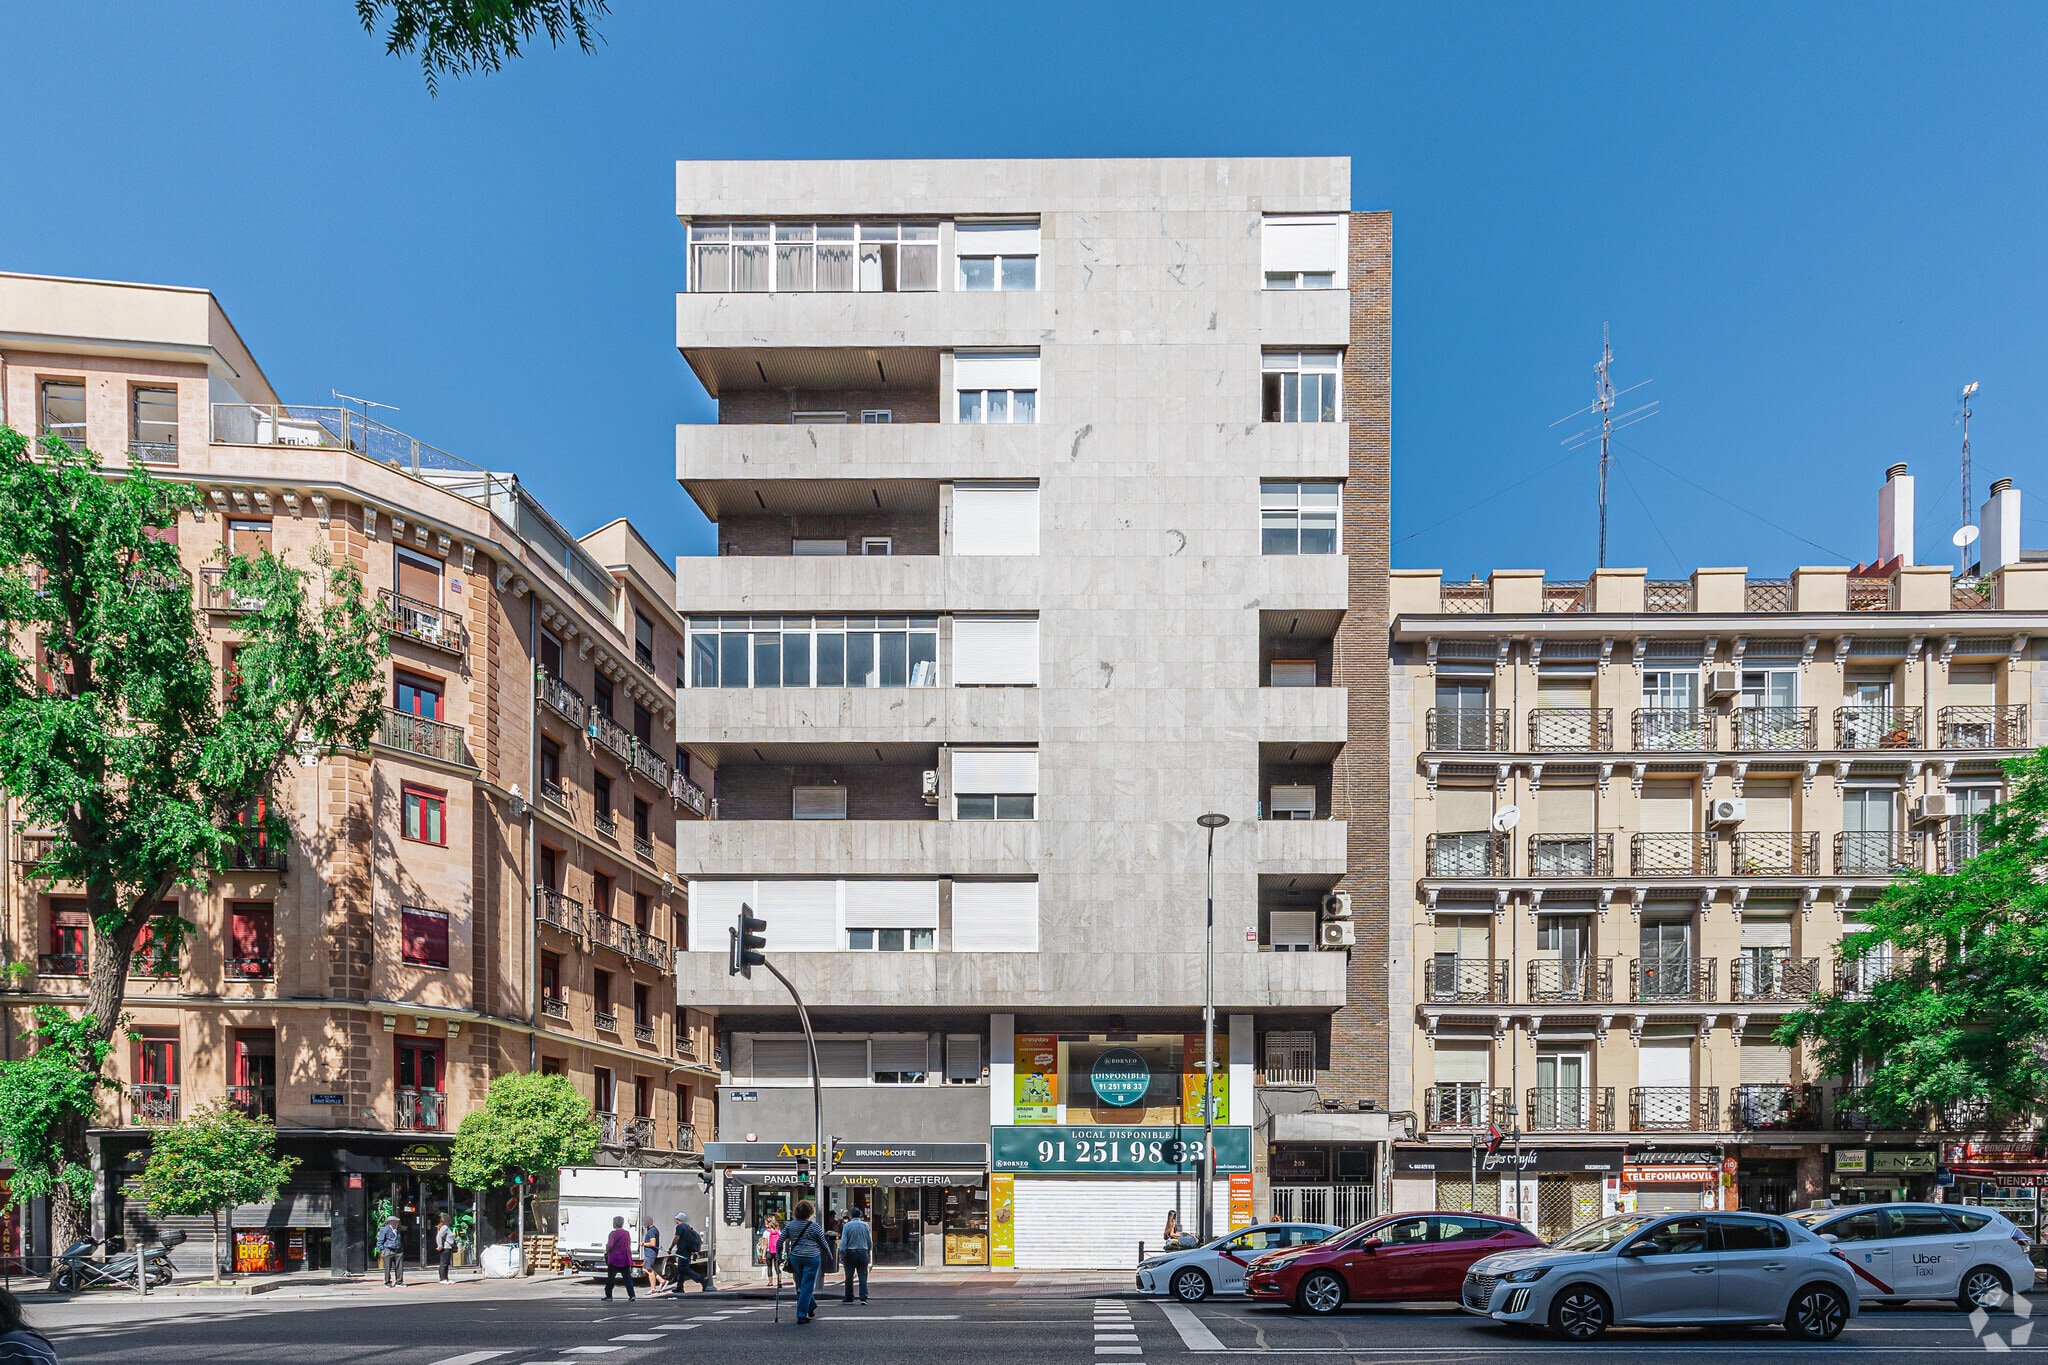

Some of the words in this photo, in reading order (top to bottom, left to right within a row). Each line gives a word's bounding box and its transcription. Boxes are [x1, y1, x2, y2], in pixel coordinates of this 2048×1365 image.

[1095, 1072, 1147, 1080] DISPONIBLE
[1072, 1131, 1106, 1139] LOCAL
[1109, 1131, 1171, 1139] DISPONIBLE
[776, 1143, 846, 1163] Audy
[855, 1149, 916, 1157] BRUNCH&COFFEE
[1038, 1140, 1068, 1163] 91
[1075, 1140, 1121, 1163] 251
[1130, 1140, 1163, 1163] 98
[1172, 1140, 1205, 1163] 33
[764, 1175, 815, 1184] PANADRI
[840, 1174, 879, 1186] Audrey
[893, 1175, 951, 1185] CAFETERIA
[1626, 1172, 1714, 1181] TELEFONIAMOVIL
[1997, 1176, 2034, 1186] TIENDA
[1912, 1253, 1941, 1264] Uber
[1913, 1265, 1934, 1277] Taxi
